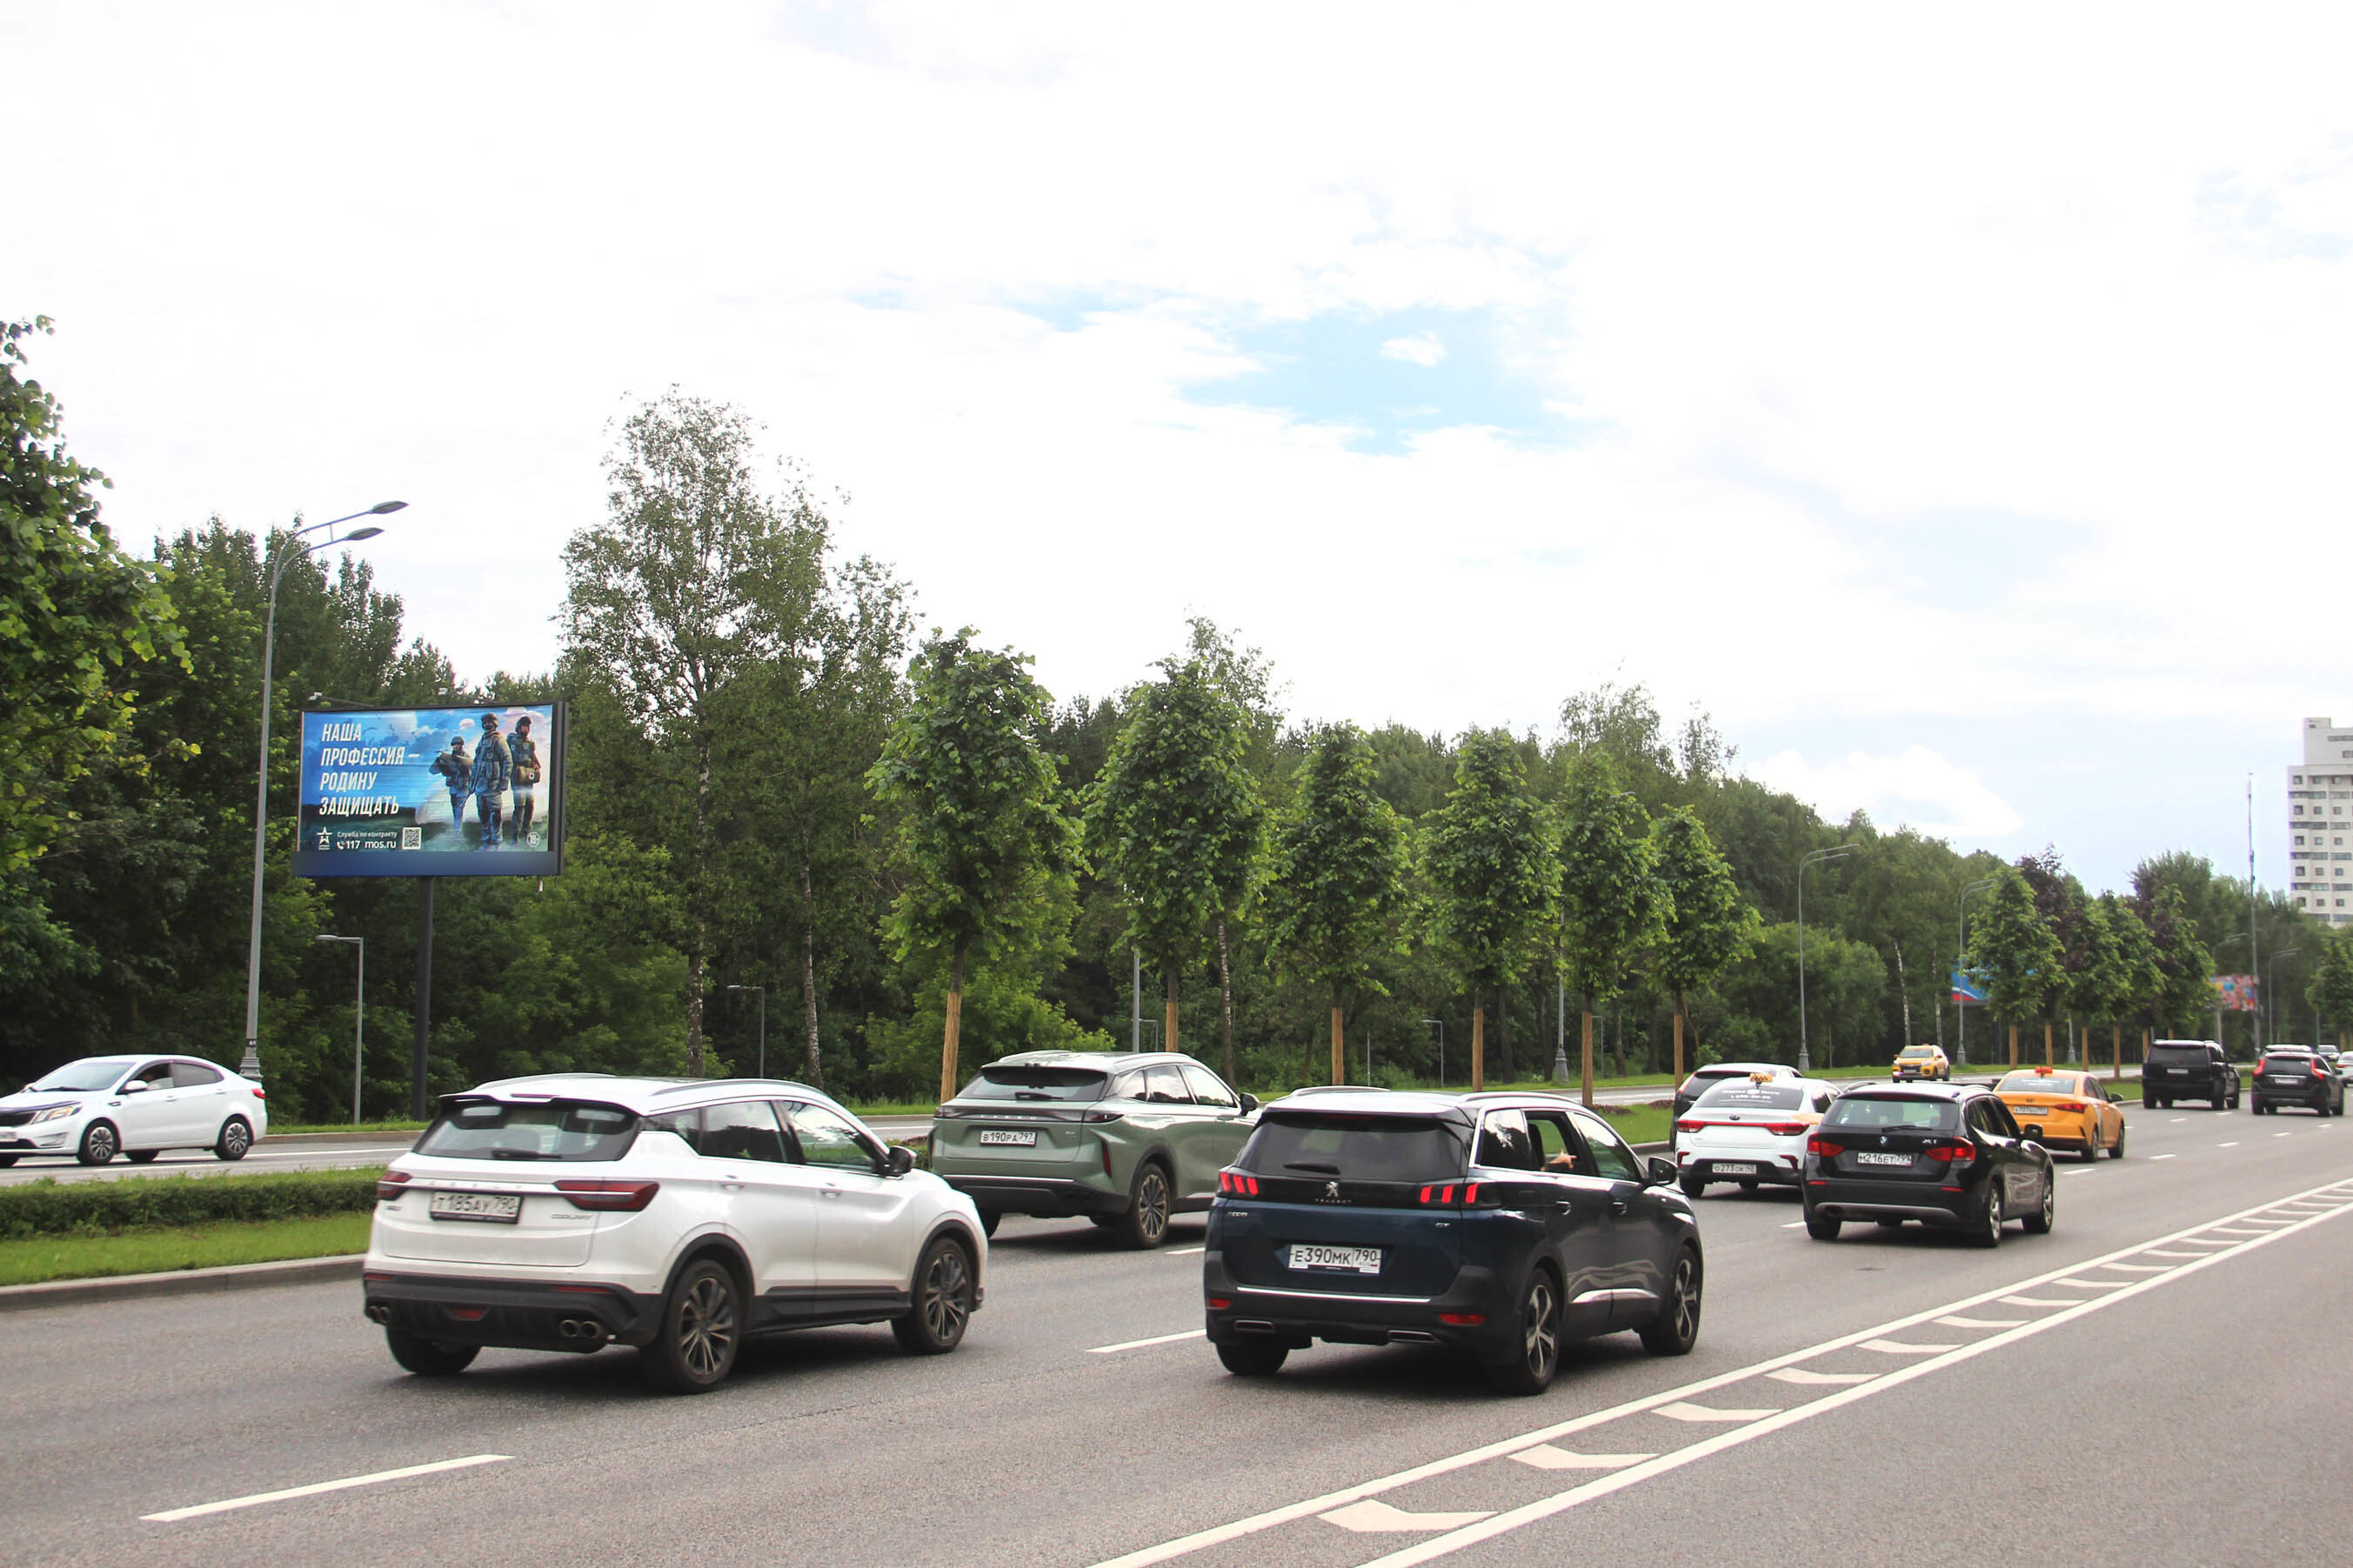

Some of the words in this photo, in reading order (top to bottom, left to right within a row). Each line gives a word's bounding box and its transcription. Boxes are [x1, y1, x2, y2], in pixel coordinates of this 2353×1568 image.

[321, 723, 362, 742] НАША
[320, 746, 405, 766] ПРОФЕССИЯ
[319, 771, 378, 792] РОДИНУ
[318, 796, 399, 817] ЗАЩИЩАТЬ
[346, 840, 361, 850] 117
[364, 840, 397, 849] mos.ru
[1294, 1247, 1351, 1264] Е390МК
[1354, 1249, 1377, 1262] 790
